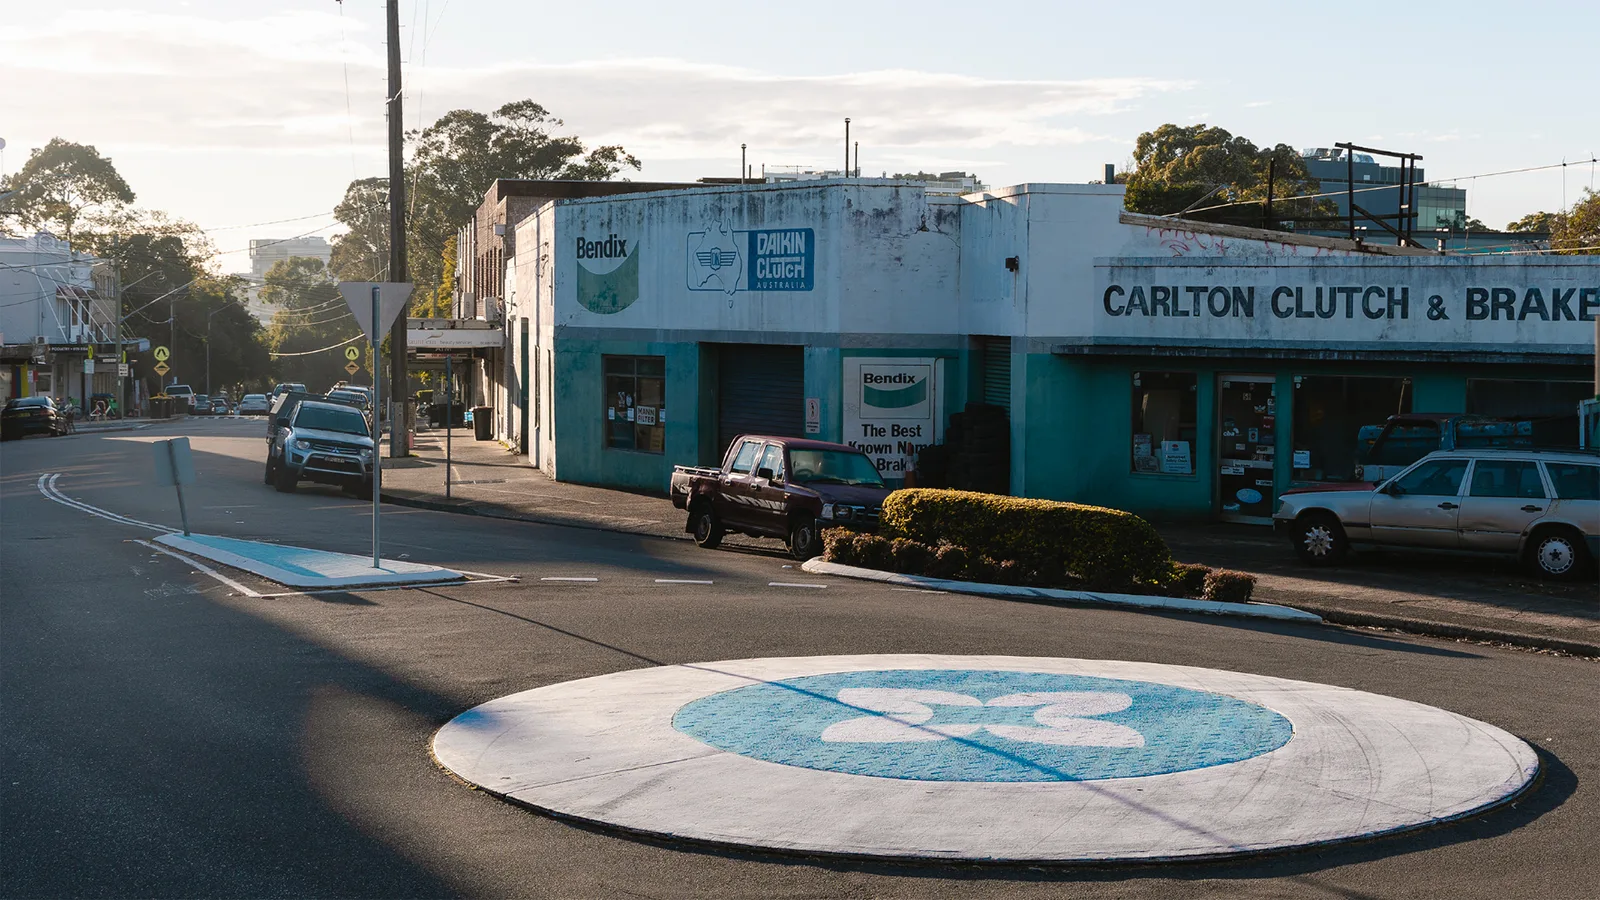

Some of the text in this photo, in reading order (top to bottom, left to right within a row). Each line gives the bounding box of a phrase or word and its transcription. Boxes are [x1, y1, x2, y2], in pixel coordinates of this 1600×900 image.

[576, 233, 628, 259] Bendix
[756, 231, 806, 255] DAIKIN
[756, 281, 806, 289] AUSTRALIA
[1103, 285, 1254, 318] CARLTON
[1270, 285, 1409, 319] CLUTCH
[1426, 294, 1450, 321] &
[863, 373, 916, 384] Bendix
[637, 407, 655, 416] MANN
[637, 415, 655, 424] FILTER
[861, 424, 922, 437] The Best
[848, 441, 892, 454] Known
